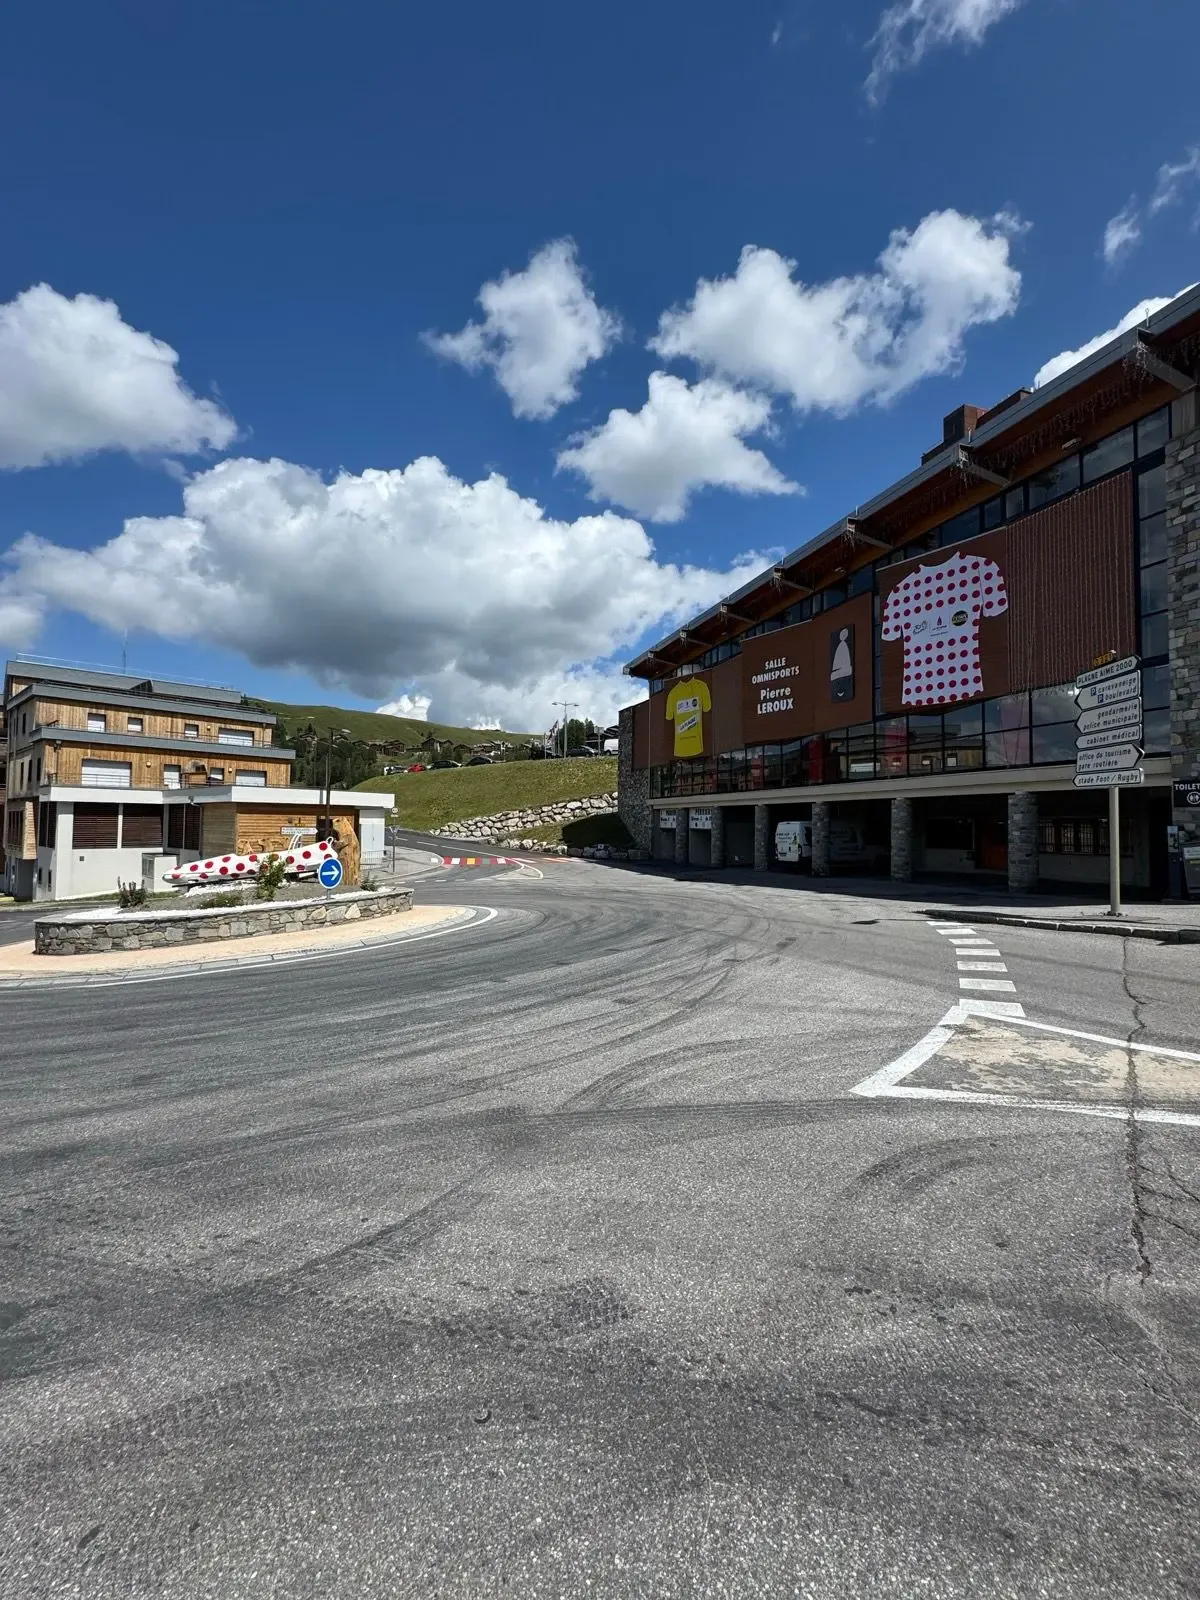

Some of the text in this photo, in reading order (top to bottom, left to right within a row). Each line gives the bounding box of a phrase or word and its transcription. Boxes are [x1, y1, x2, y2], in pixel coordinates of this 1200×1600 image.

[765, 657, 786, 670] SALLE
[1078, 671, 1098, 684] PLAGNE
[1100, 665, 1115, 677] AIME
[1116, 659, 1133, 672] 2000
[752, 666, 800, 684] OMNISPORTS
[1098, 677, 1137, 693] caravaneige
[760, 687, 791, 700] Pierre
[1105, 686, 1137, 701] boulevard
[757, 698, 794, 714] LEROUX
[1097, 703, 1138, 720] gendarmerie
[1083, 713, 1138, 731] police municipale
[1087, 729, 1139, 745] cabinet médical
[1079, 753, 1094, 761] office
[1105, 749, 1132, 757] tourisme
[1079, 763, 1091, 771] gare
[1096, 775, 1110, 783] Foot
[1118, 773, 1139, 783] Rugby
